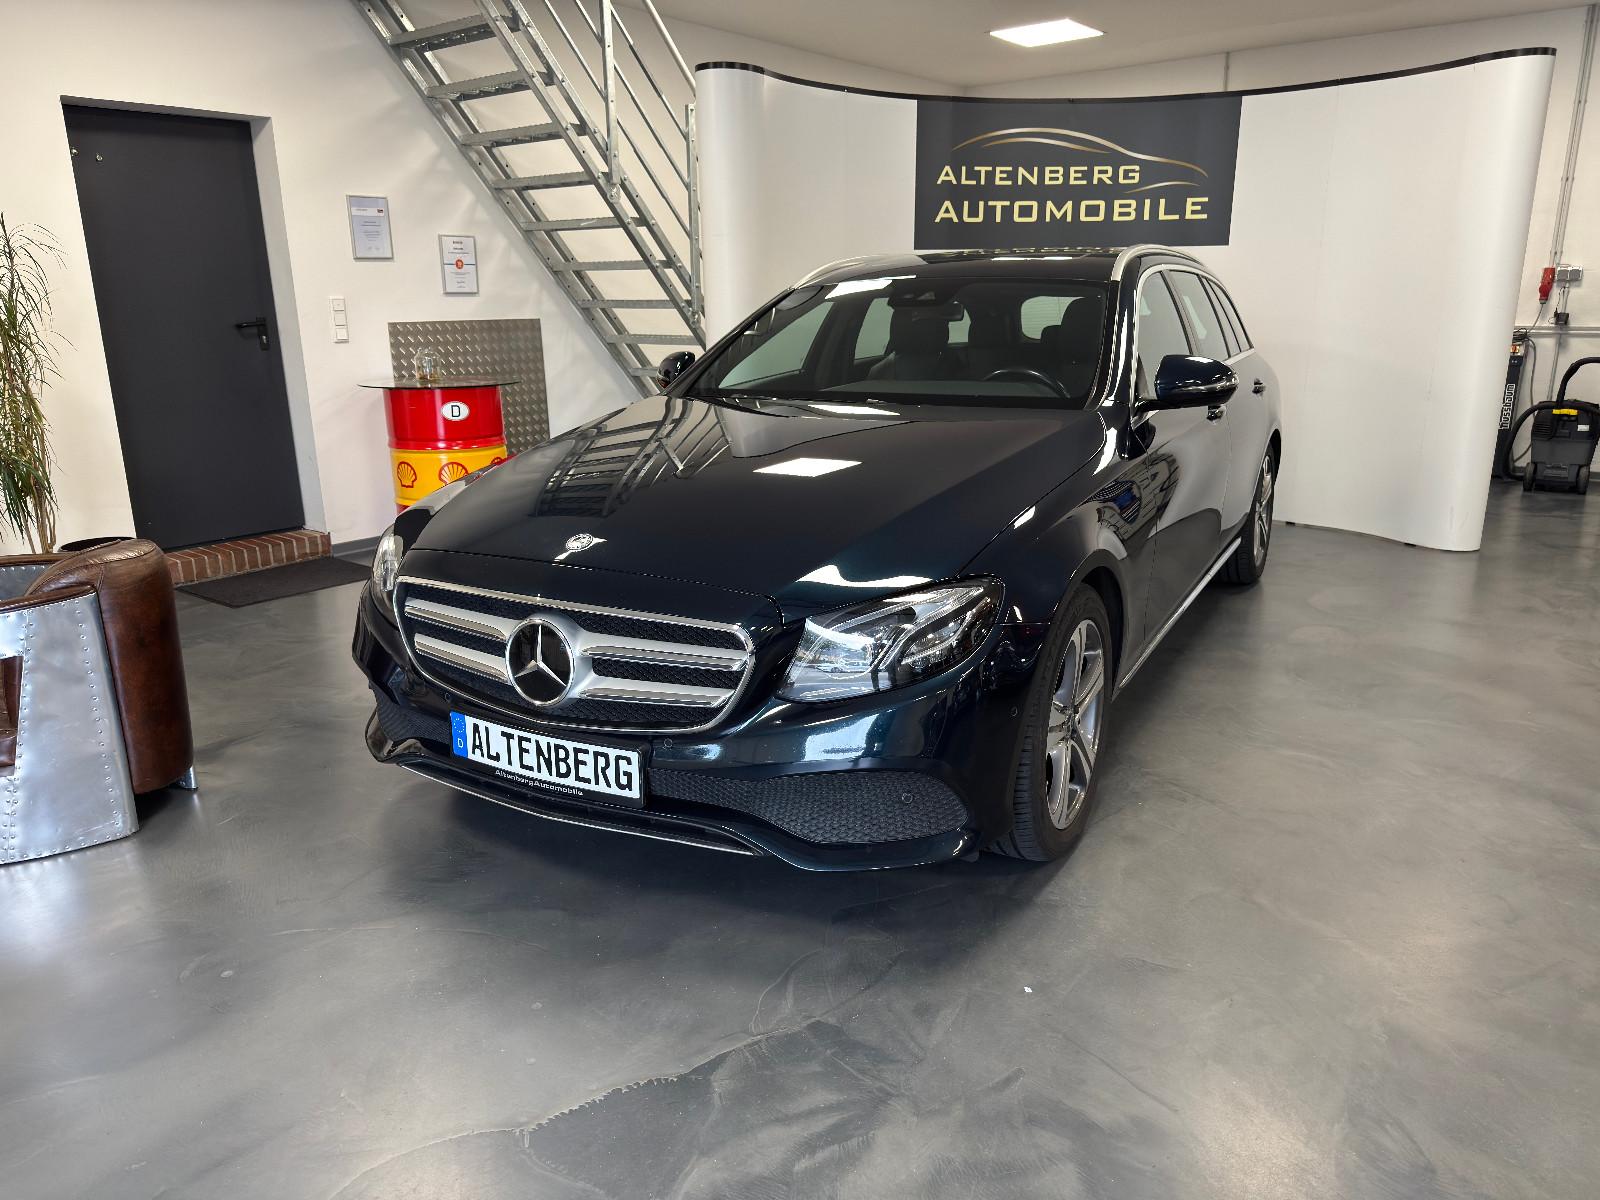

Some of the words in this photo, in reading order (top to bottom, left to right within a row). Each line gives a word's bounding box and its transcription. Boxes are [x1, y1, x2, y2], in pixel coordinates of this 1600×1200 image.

[937, 165, 1140, 185] ALTENBERG
[935, 197, 1209, 223] AUTOMOBILE
[451, 404, 461, 418] D
[457, 737, 464, 748] D
[471, 722, 633, 792] ALTENBERG
